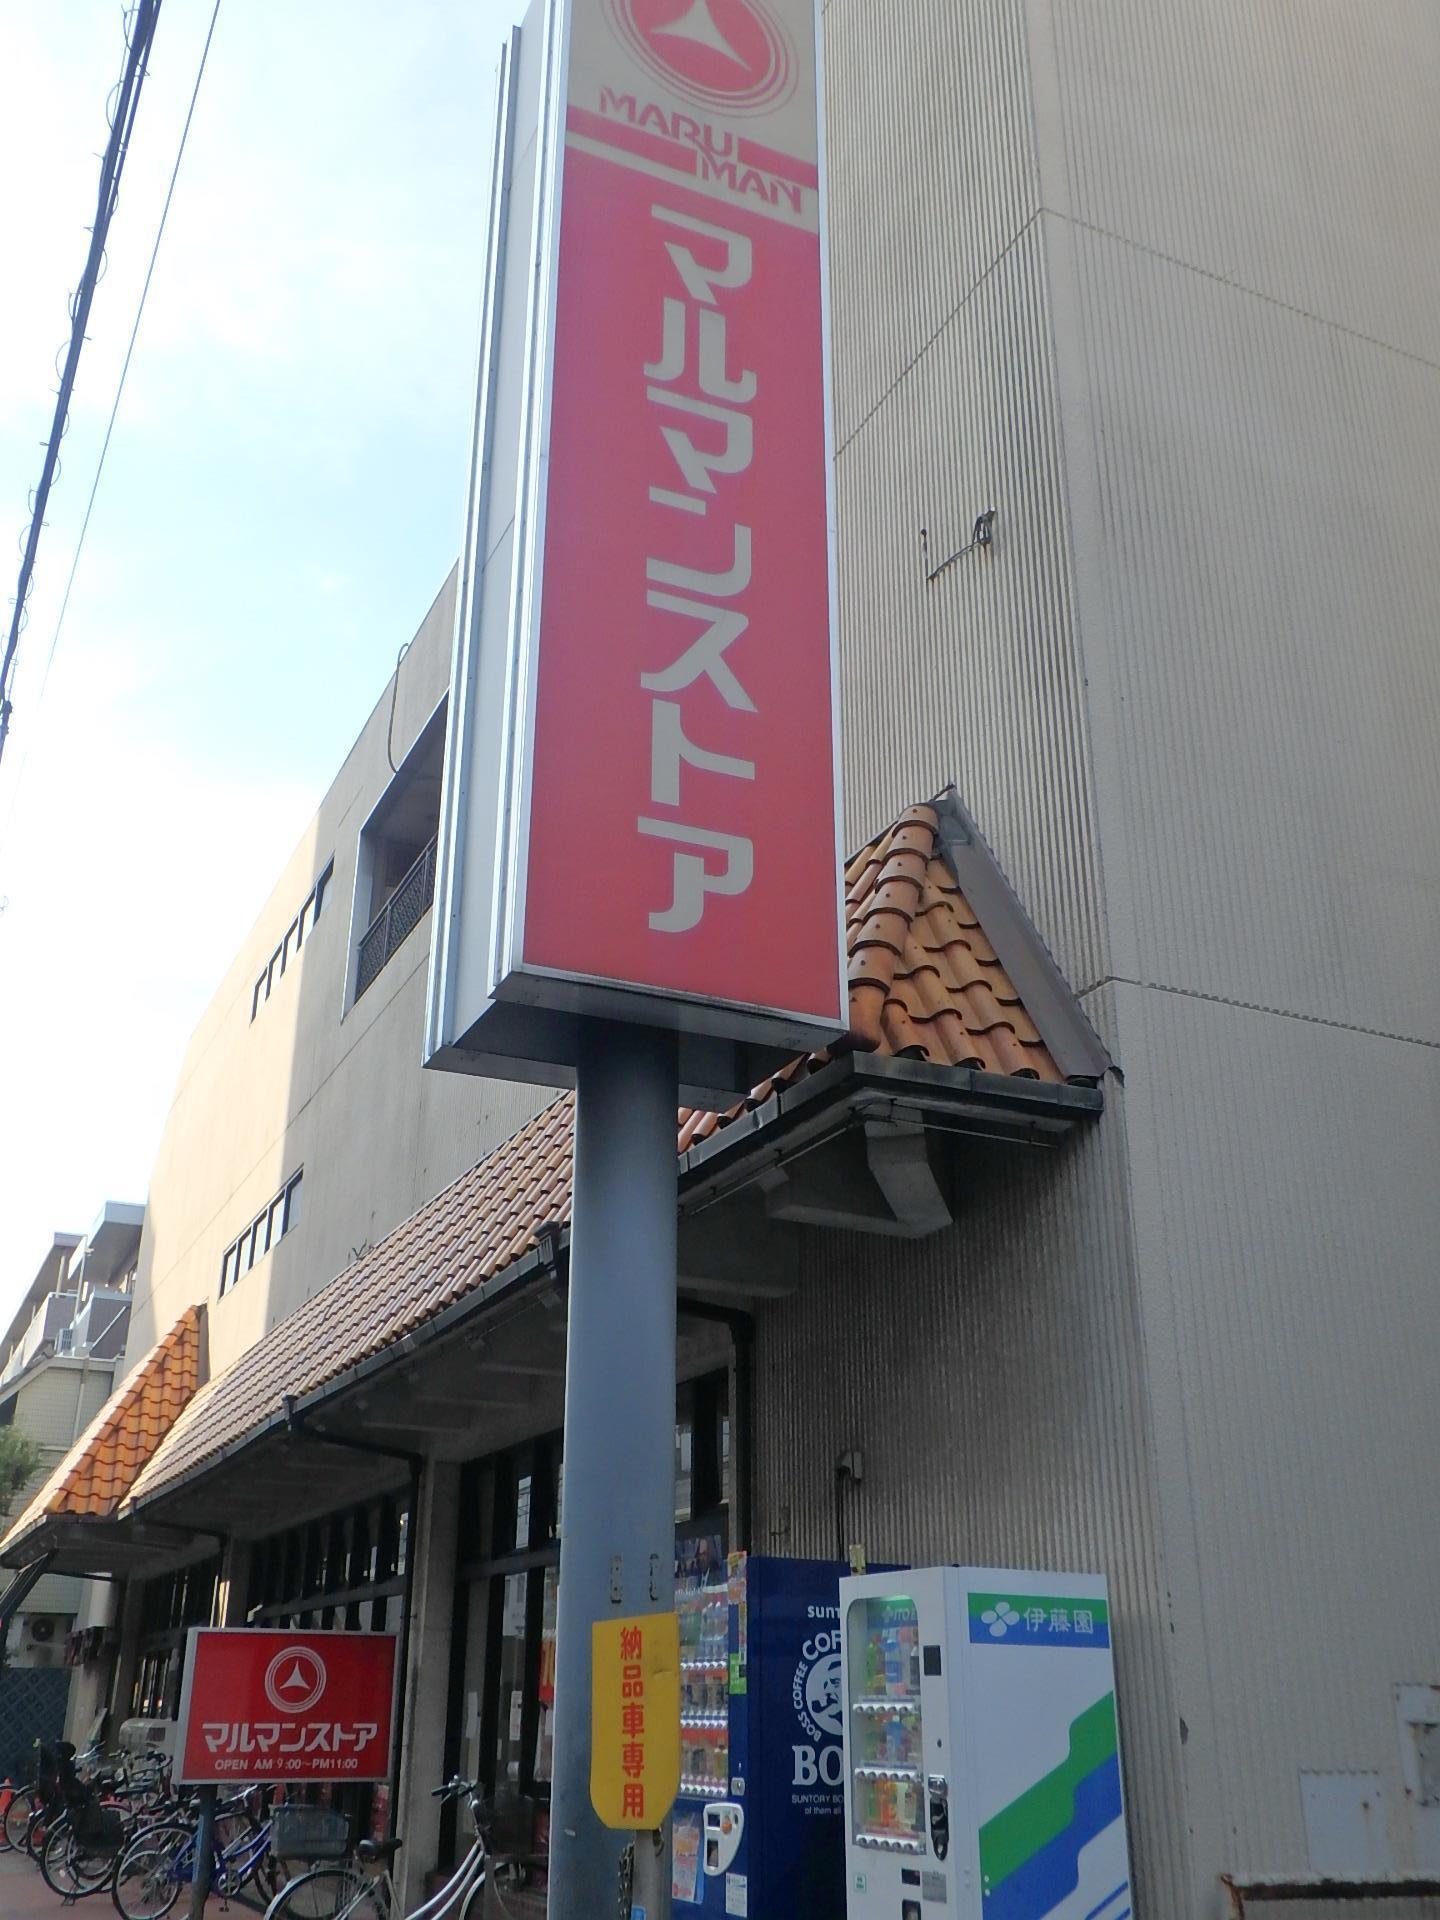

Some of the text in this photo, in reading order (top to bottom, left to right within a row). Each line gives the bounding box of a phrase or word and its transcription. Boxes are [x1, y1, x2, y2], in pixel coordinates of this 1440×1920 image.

[600, 86, 738, 158] MARU
[698, 150, 802, 214] MAN
[637, 203, 759, 934] マルマンストア
[1023, 1607, 1094, 1634] 伊藤園
[620, 1625, 645, 1819] 納品車専用
[792, 1661, 822, 1742] BOSS COFFEE
[202, 1723, 378, 1753] マルマンストア
[214, 1758, 248, 1770] OPEN
[253, 1758, 273, 1770] AM
[791, 1794, 830, 1804] SUNTORY
